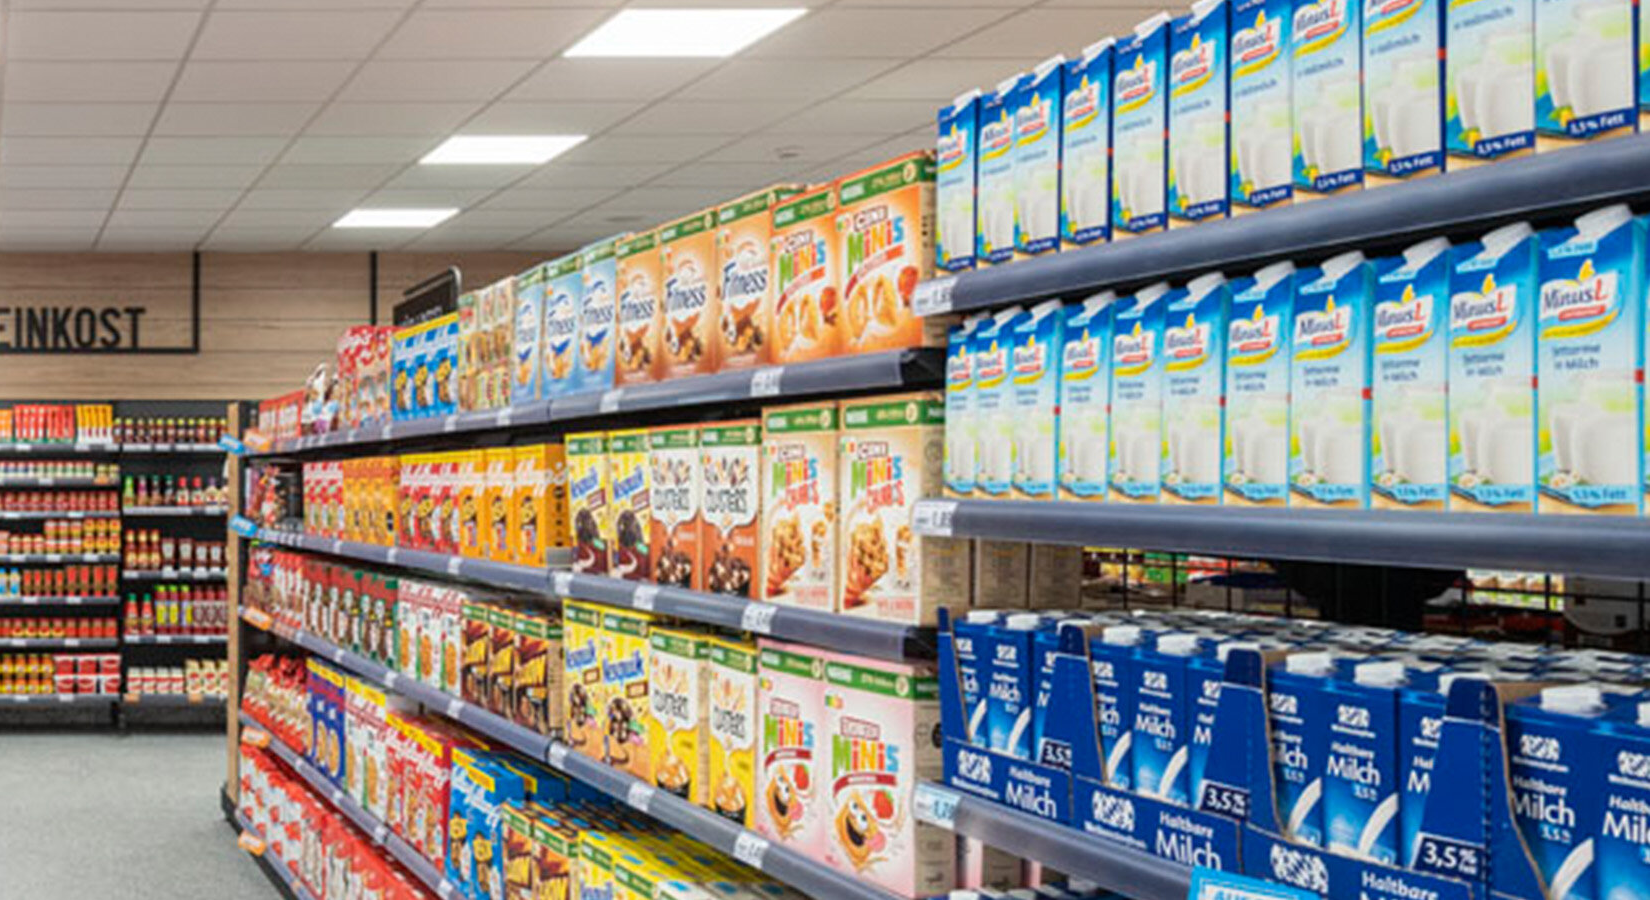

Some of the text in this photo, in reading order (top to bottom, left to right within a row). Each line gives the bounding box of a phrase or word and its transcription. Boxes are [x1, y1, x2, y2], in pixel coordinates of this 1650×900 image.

[1135, 713, 1176, 740] Milch
[1326, 755, 1382, 787] Milch
[1005, 781, 1057, 819] Milch
[1514, 793, 1576, 828] Milch
[1156, 828, 1222, 872] Milch
[1361, 870, 1439, 900] Haltbare
